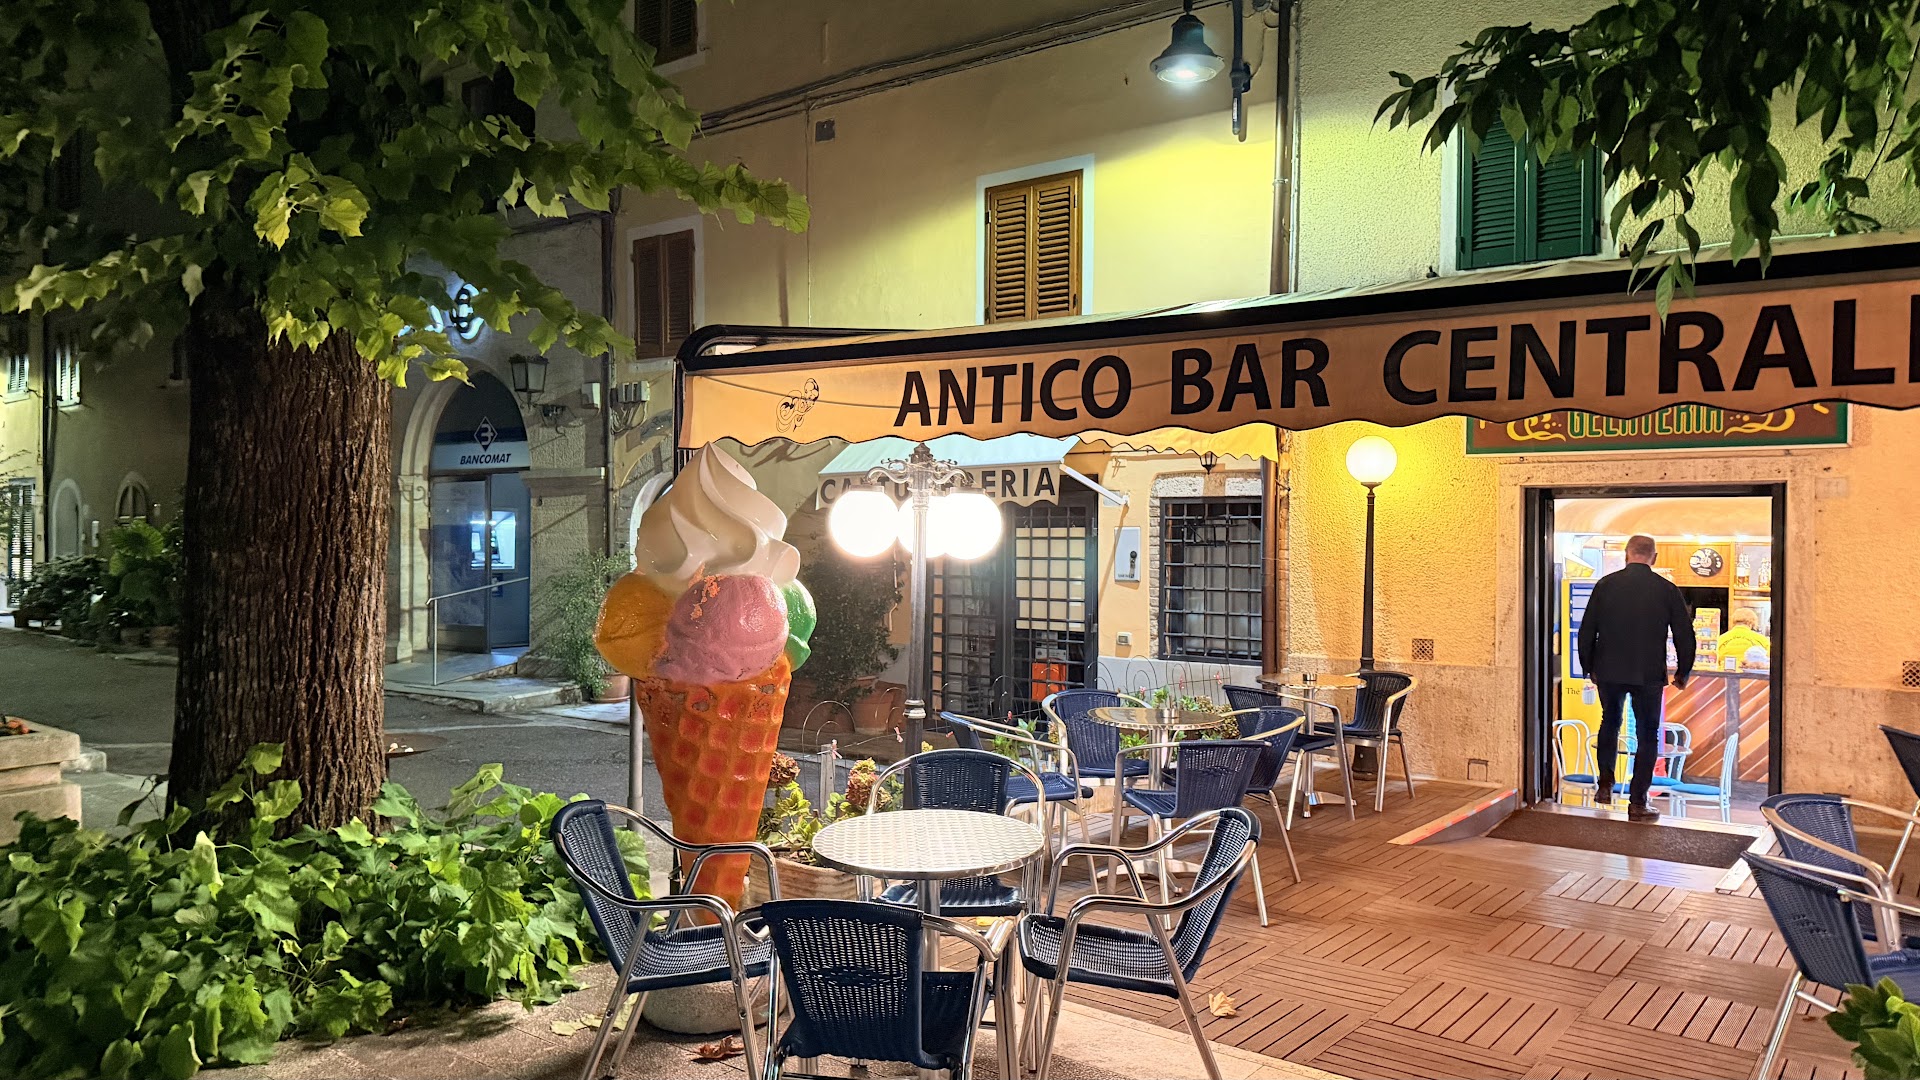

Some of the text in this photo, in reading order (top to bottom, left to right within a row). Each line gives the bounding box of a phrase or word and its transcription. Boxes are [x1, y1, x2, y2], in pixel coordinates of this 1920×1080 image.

[893, 292, 1920, 427] ANTICO BAR CENTRAL
[459, 453, 512, 465] BANCOMAT
